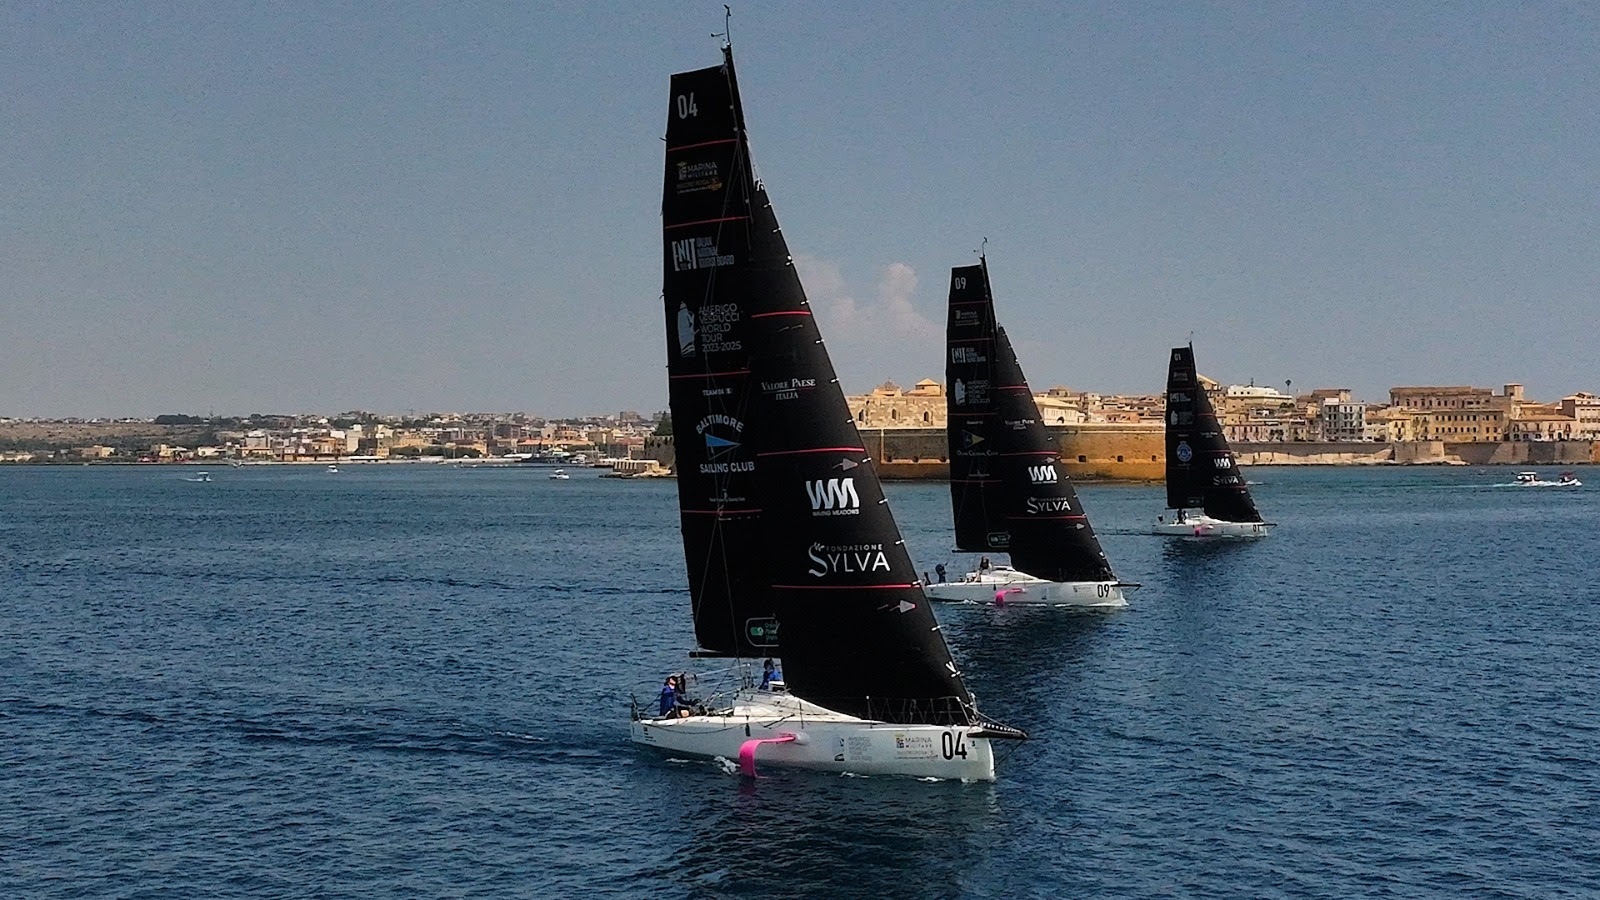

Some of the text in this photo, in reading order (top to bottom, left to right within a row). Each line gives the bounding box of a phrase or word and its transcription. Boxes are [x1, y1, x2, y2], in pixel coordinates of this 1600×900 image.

[677, 92, 698, 119] 04
[954, 276, 967, 290] 09
[701, 322, 732, 333] WORLD
[701, 332, 723, 343] TOUR
[791, 378, 816, 388] PAESE
[775, 391, 799, 401] ITALIA
[695, 414, 744, 435] BALTIMORE
[699, 461, 755, 474] SAILING CLUB
[1027, 497, 1072, 514] SYLVA
[826, 543, 883, 552] FONDAZIONE
[807, 542, 891, 578] SYLVA
[1097, 584, 1110, 598] 09
[942, 732, 968, 760] 04
